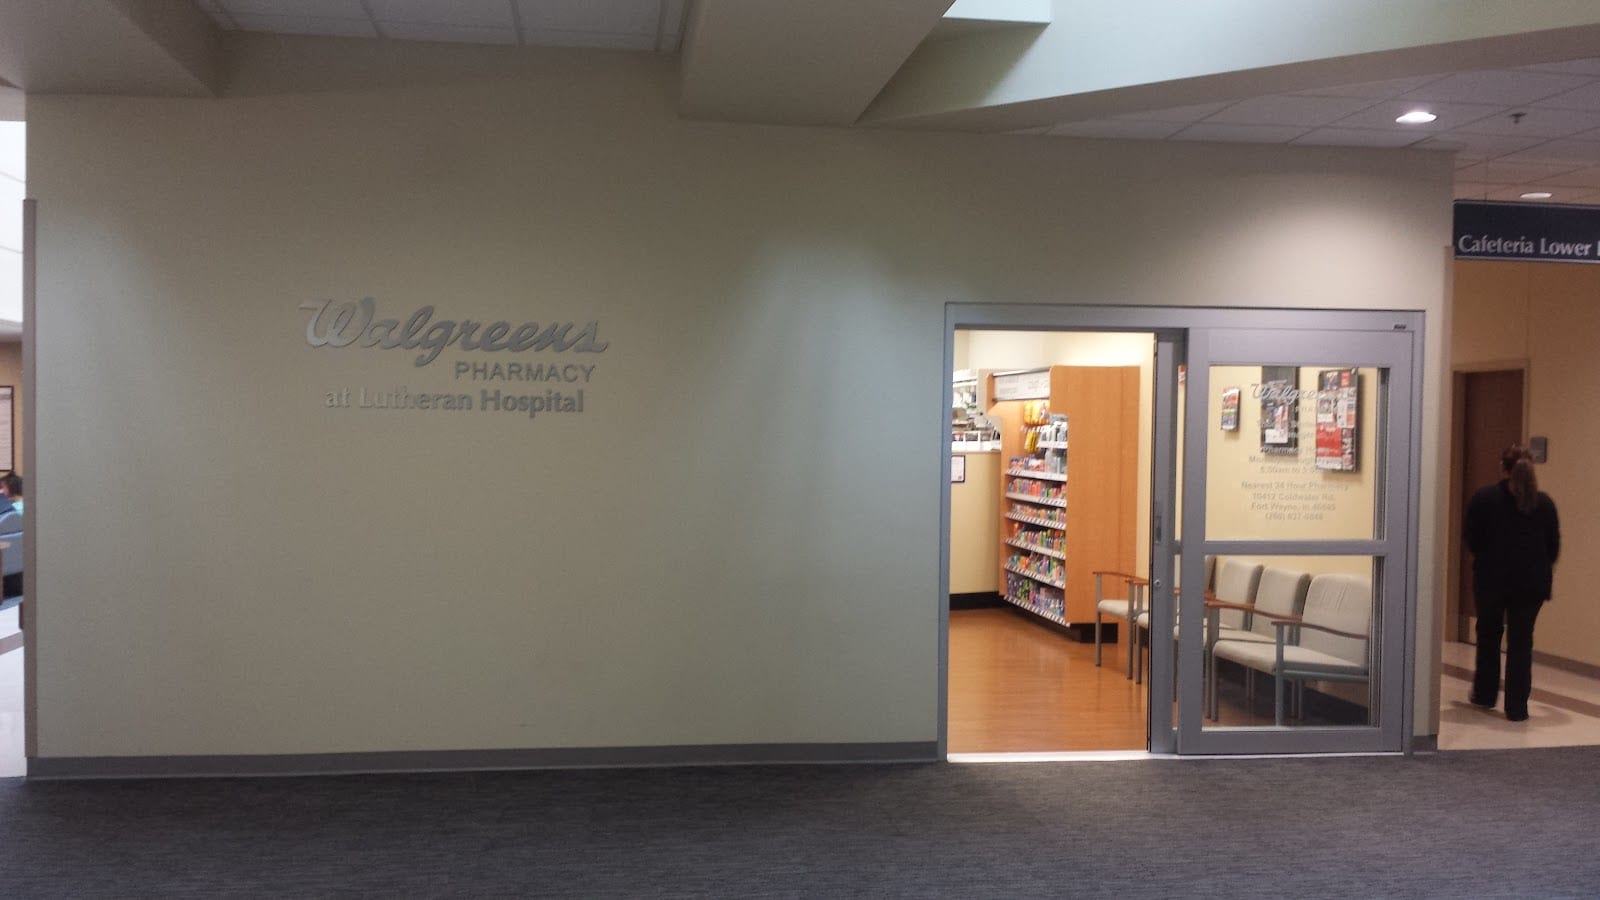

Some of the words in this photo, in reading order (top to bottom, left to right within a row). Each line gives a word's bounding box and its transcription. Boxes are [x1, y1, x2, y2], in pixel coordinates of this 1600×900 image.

[1458, 234, 1534, 255] Cafeteria
[1540, 237, 1592, 256] Lower
[299, 297, 609, 367] Walgreens
[455, 361, 596, 383] PHARMACY
[325, 388, 350, 408] at
[359, 386, 473, 410] Lutheran
[480, 389, 584, 418] Hospital
